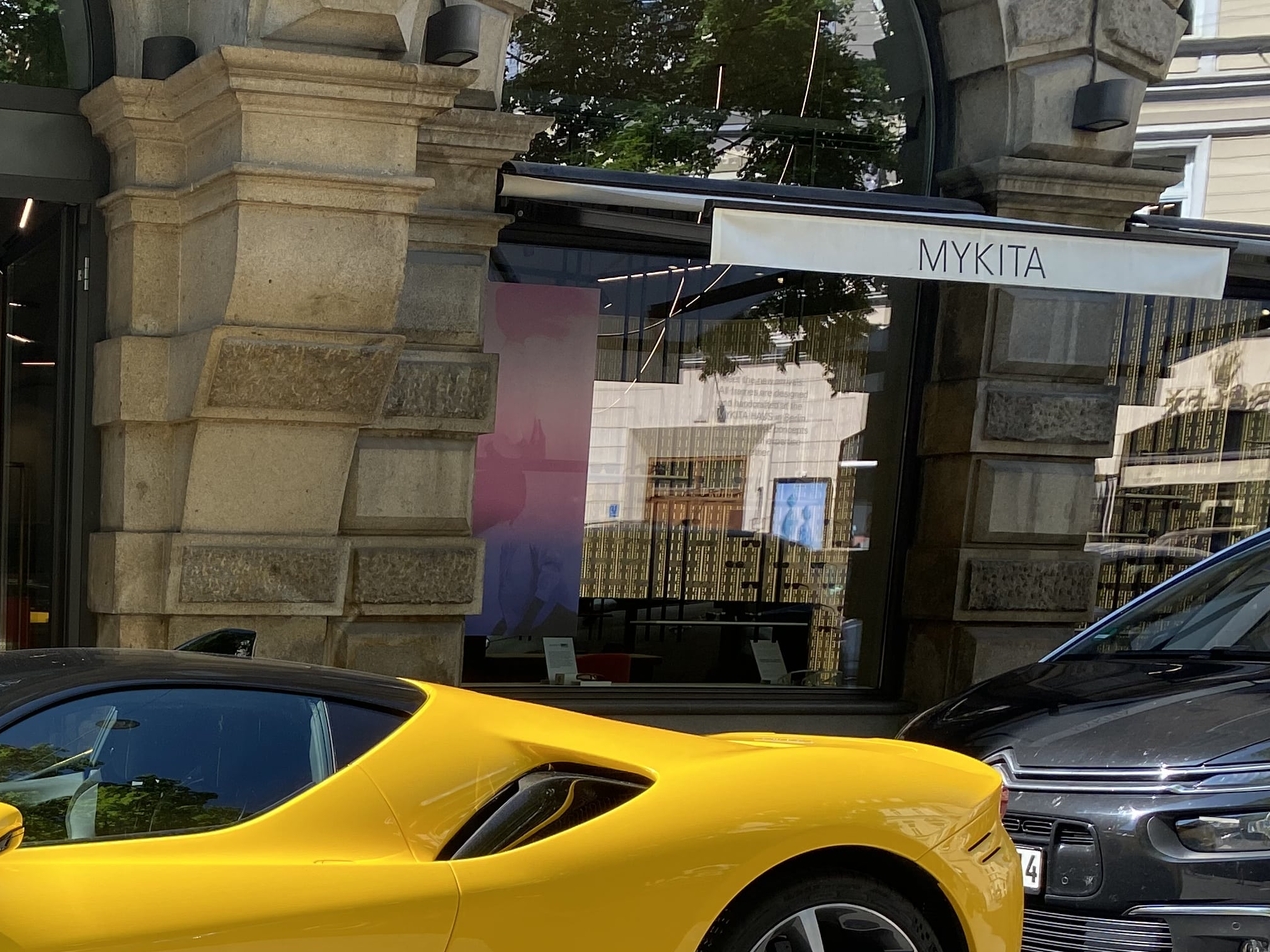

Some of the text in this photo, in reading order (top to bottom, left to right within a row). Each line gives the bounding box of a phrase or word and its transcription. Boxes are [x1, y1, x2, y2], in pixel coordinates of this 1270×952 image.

[919, 238, 1046, 279] MYKITA
[775, 389, 808, 399] designed
[1019, 853, 1038, 884] 4
